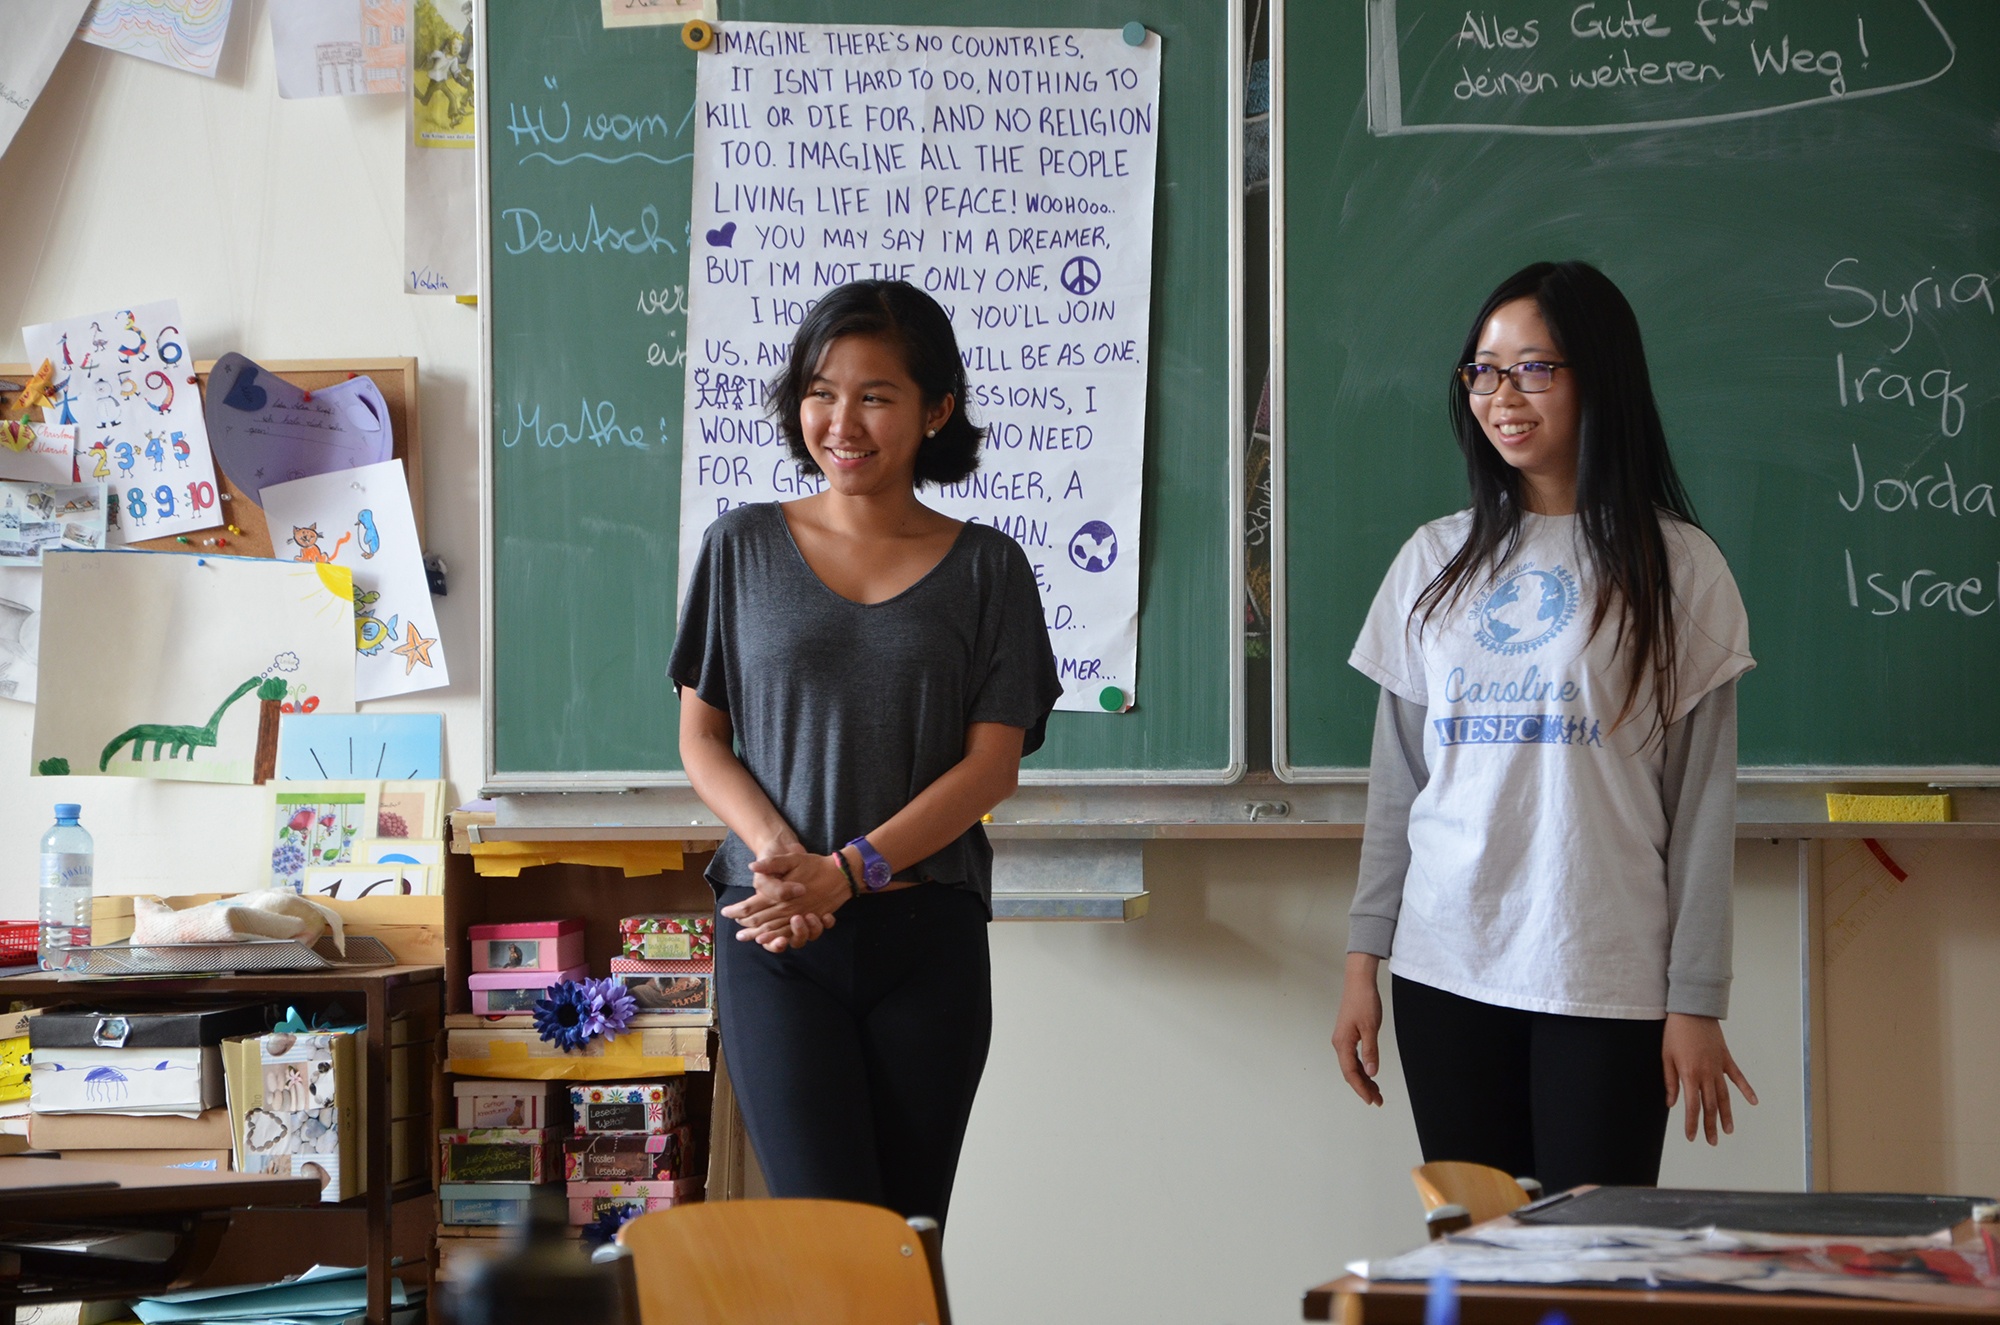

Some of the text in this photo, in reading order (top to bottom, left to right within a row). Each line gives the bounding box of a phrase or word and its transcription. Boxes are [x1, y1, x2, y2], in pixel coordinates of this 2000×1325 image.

[713, 28, 810, 56] IMAGINE
[823, 32, 909, 56] THERE'S
[916, 34, 942, 52] NO
[1456, 0, 1769, 50] Alles Gute für
[731, 66, 1137, 95] IT ISN'T HARD TO DO, NOTHING TO
[1454, 65, 1558, 100] deinen
[1570, 48, 1725, 89] weiteren
[507, 75, 570, 145] HÜ
[583, 113, 668, 142] vom
[706, 101, 751, 129] KILL
[767, 106, 793, 127] OR
[808, 104, 852, 129] DIE
[866, 105, 925, 133] FOR,
[933, 104, 984, 133] AND
[996, 108, 1031, 132] NO
[1040, 103, 1151, 137] RELIGION
[721, 140, 1129, 177] TOO. IMAGINE ALL THE PEOPLE
[715, 182, 803, 215] LIVING
[817, 187, 869, 216] LIFE
[887, 186, 909, 217] IN
[925, 185, 1016, 218] PEACE!
[755, 225, 1110, 255] YOU MAY SAY I'M A DREAMER,
[706, 256, 1047, 294] BUT I'M NOT THE ONLY ONE,
[751, 296, 763, 324] I
[971, 304, 1049, 329] YOU'LL
[1059, 300, 1114, 324] JOIN
[1825, 257, 1994, 353] Syria
[706, 339, 748, 366] US,
[1021, 344, 1051, 370] BE
[1057, 343, 1085, 366] AS
[1094, 340, 1139, 364] ONE.
[967, 384, 1097, 415] SSIONS, I
[1836, 352, 1969, 437] Iraq
[503, 397, 667, 448] Mathe:
[700, 415, 1092, 451] WONDE NO NEED
[699, 455, 752, 486] FOR
[1064, 470, 1083, 499] A
[1838, 443, 1997, 517] Jorda
[1445, 665, 1581, 703] Caroline
[1440, 716, 1541, 745] AIESEC
[590, 1106, 631, 1118] Lesedose
[595, 1167, 627, 1176] Lesedose
